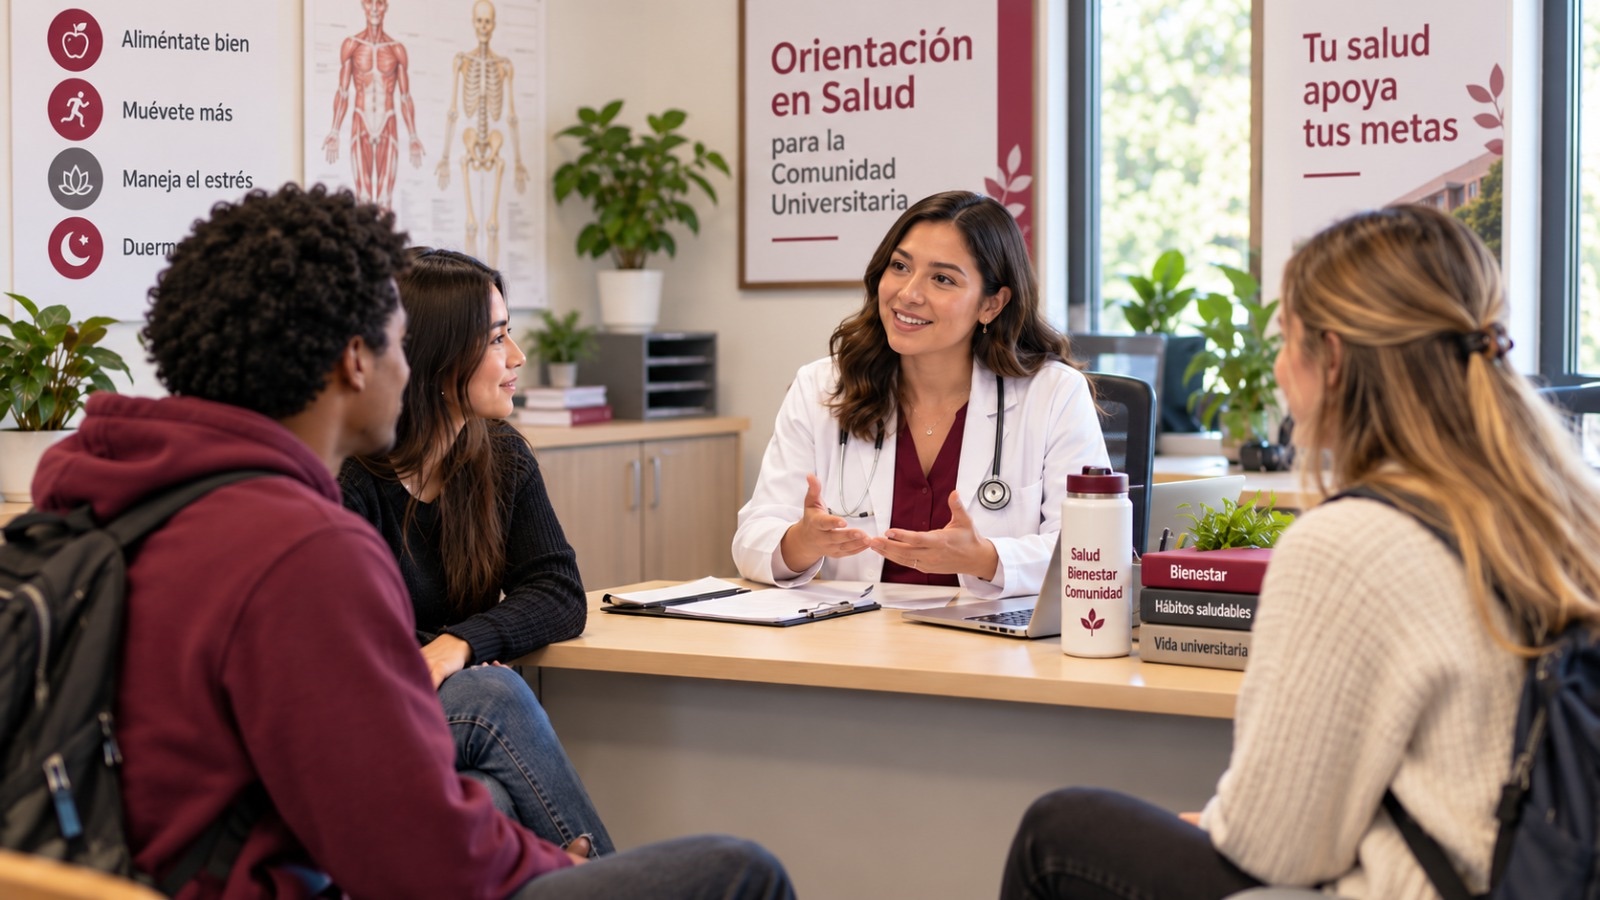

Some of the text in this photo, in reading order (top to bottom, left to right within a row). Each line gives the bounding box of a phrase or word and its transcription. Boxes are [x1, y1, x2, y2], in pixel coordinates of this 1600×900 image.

[122, 29, 250, 52] Aliméntate bien
[771, 27, 973, 75] Orientación
[1303, 23, 1430, 63] Tu salud
[771, 74, 915, 117] en Salud
[1303, 77, 1397, 112] apoya
[122, 100, 233, 122] Muévete más
[1303, 114, 1459, 148] tus metas
[771, 129, 845, 160] para la
[122, 169, 253, 193] Maneja el estrés
[771, 157, 897, 185] Comunidad
[771, 188, 908, 215] Universitaria
[123, 238, 179, 256] Duerm
[1071, 547, 1100, 562] Salud
[1067, 566, 1118, 581] Bienestar
[1170, 564, 1228, 582] Bienestar
[1065, 585, 1123, 600] Comunidad
[1155, 599, 1252, 620] Hábitos saludables
[1154, 636, 1249, 658] Vida universitaria
